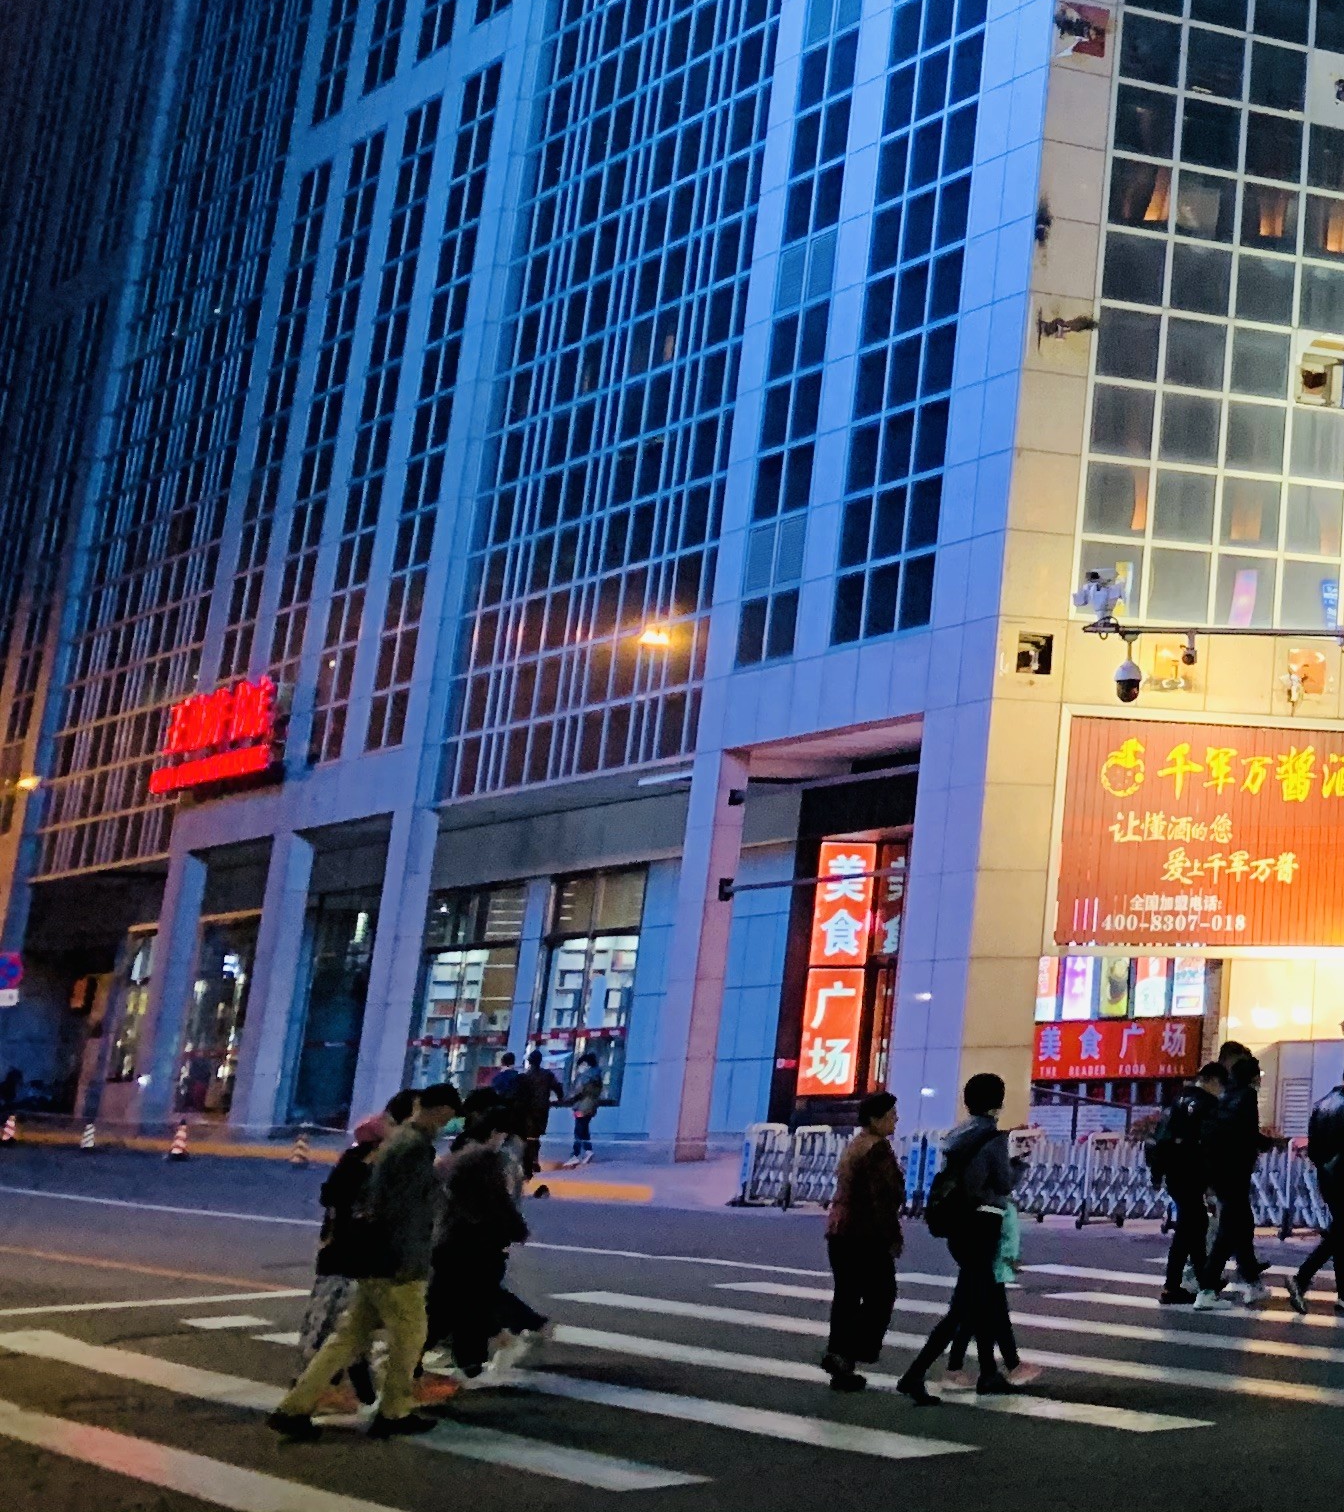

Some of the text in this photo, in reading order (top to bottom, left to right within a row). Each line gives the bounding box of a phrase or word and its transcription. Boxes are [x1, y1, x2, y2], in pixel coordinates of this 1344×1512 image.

[1108, 809, 1234, 844] 让懂酒的您
[1160, 846, 1299, 885] 爱上千军万酱
[1101, 913, 1247, 932] 400-8307-018
[805, 853, 867, 1086] 美食广场
[1038, 1021, 1187, 1061] 美食广场
[1040, 1066, 1057, 1077] THE
[1118, 1064, 1147, 1076] FOOD
